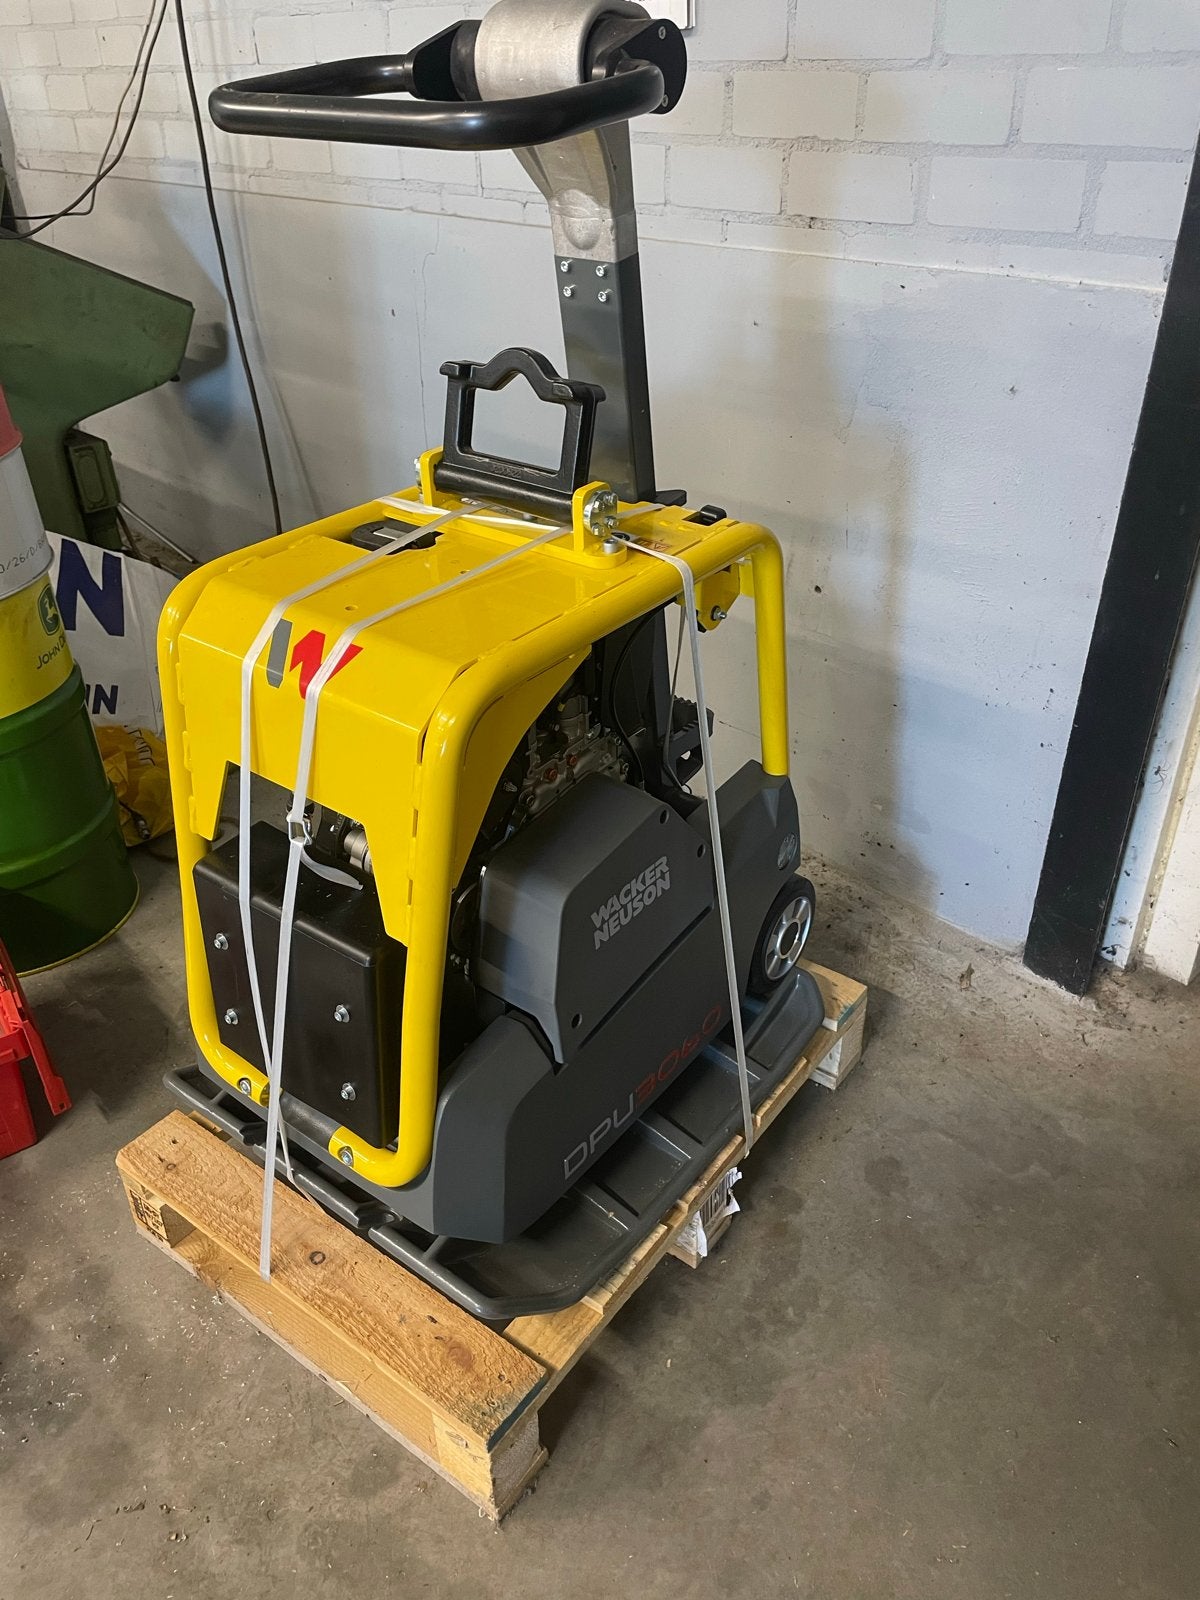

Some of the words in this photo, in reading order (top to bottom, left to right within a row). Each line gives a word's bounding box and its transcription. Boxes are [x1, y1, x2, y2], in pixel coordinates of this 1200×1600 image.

[37, 642, 60, 669] JOHN
[590, 856, 670, 929] WACKER
[593, 871, 671, 950] NEUSON
